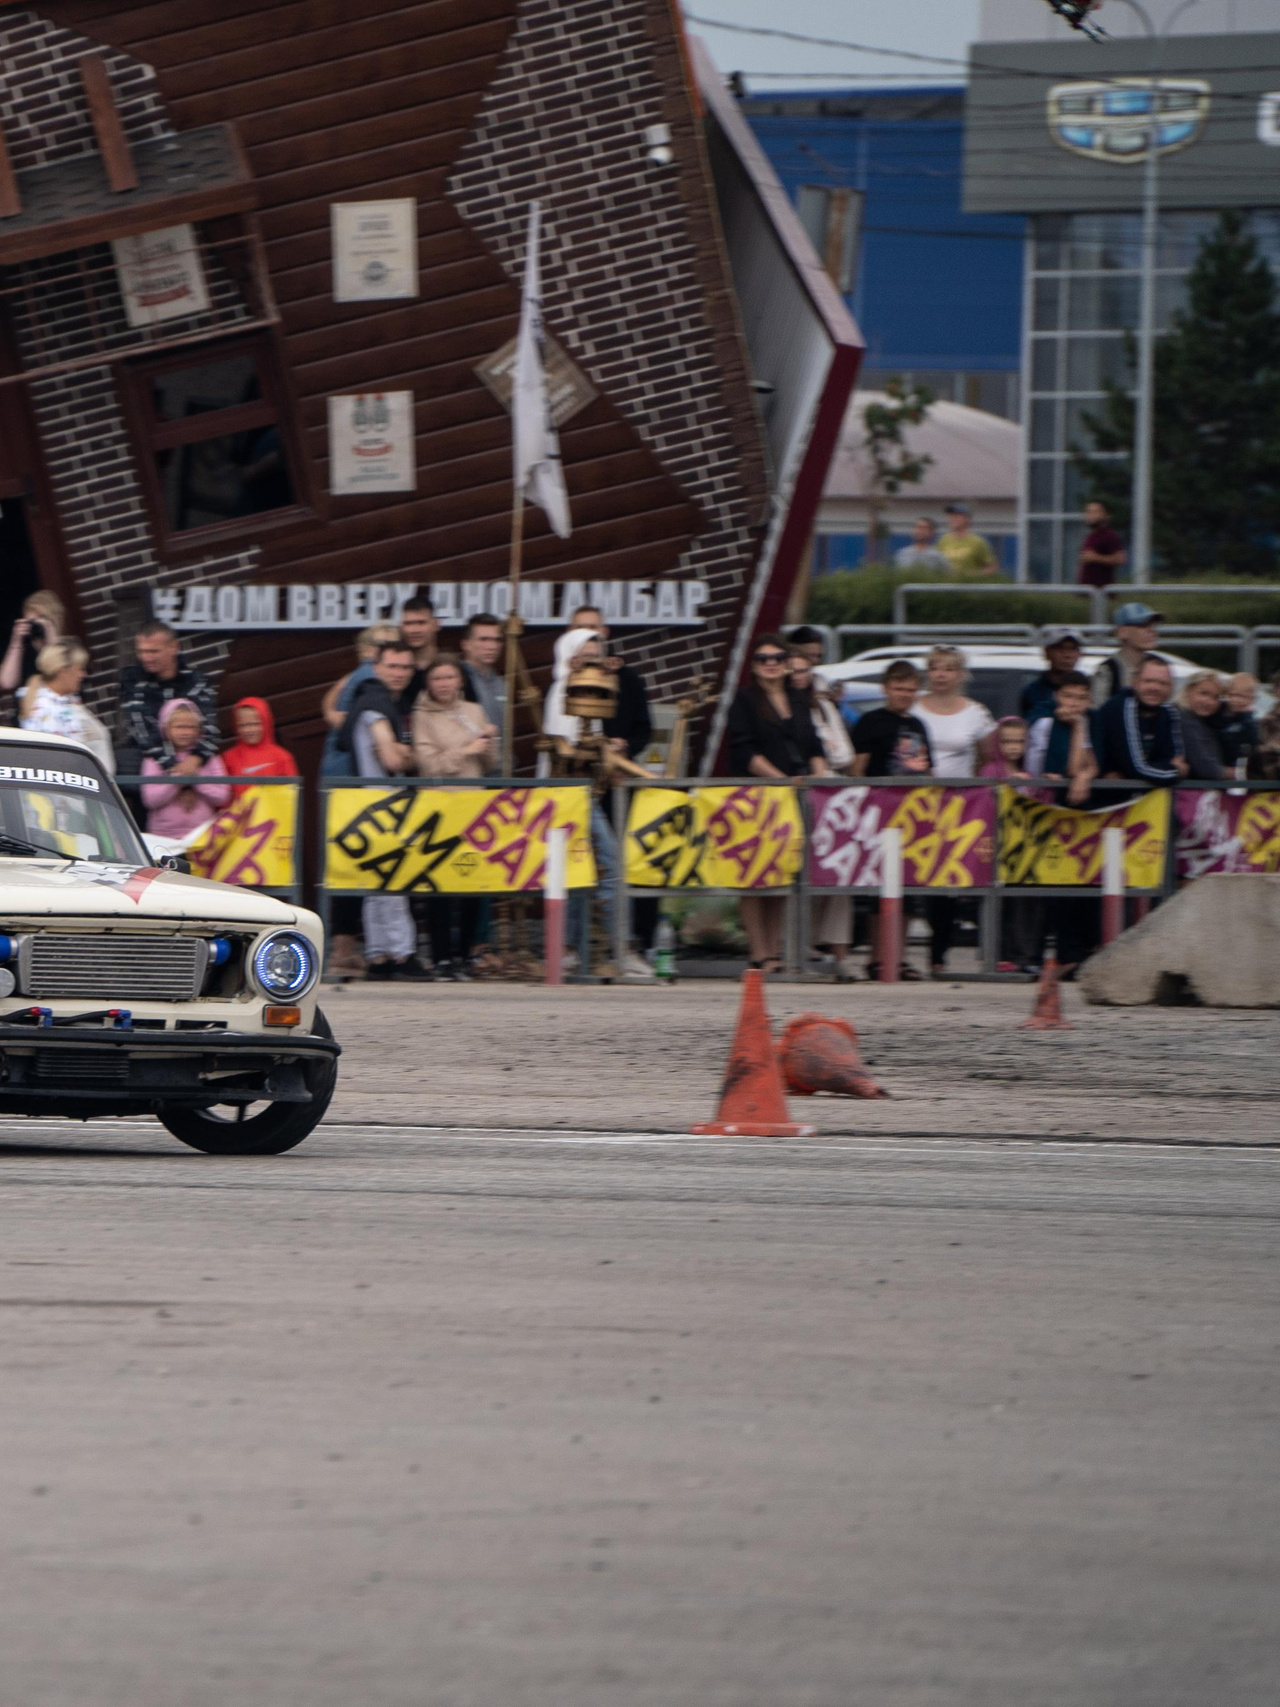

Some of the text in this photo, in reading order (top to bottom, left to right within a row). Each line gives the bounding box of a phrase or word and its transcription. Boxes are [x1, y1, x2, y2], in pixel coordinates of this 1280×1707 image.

[152, 586, 279, 623] #ДОМ
[425, 582, 554, 619] ДНОМ
[558, 580, 711, 618] АМБАР
